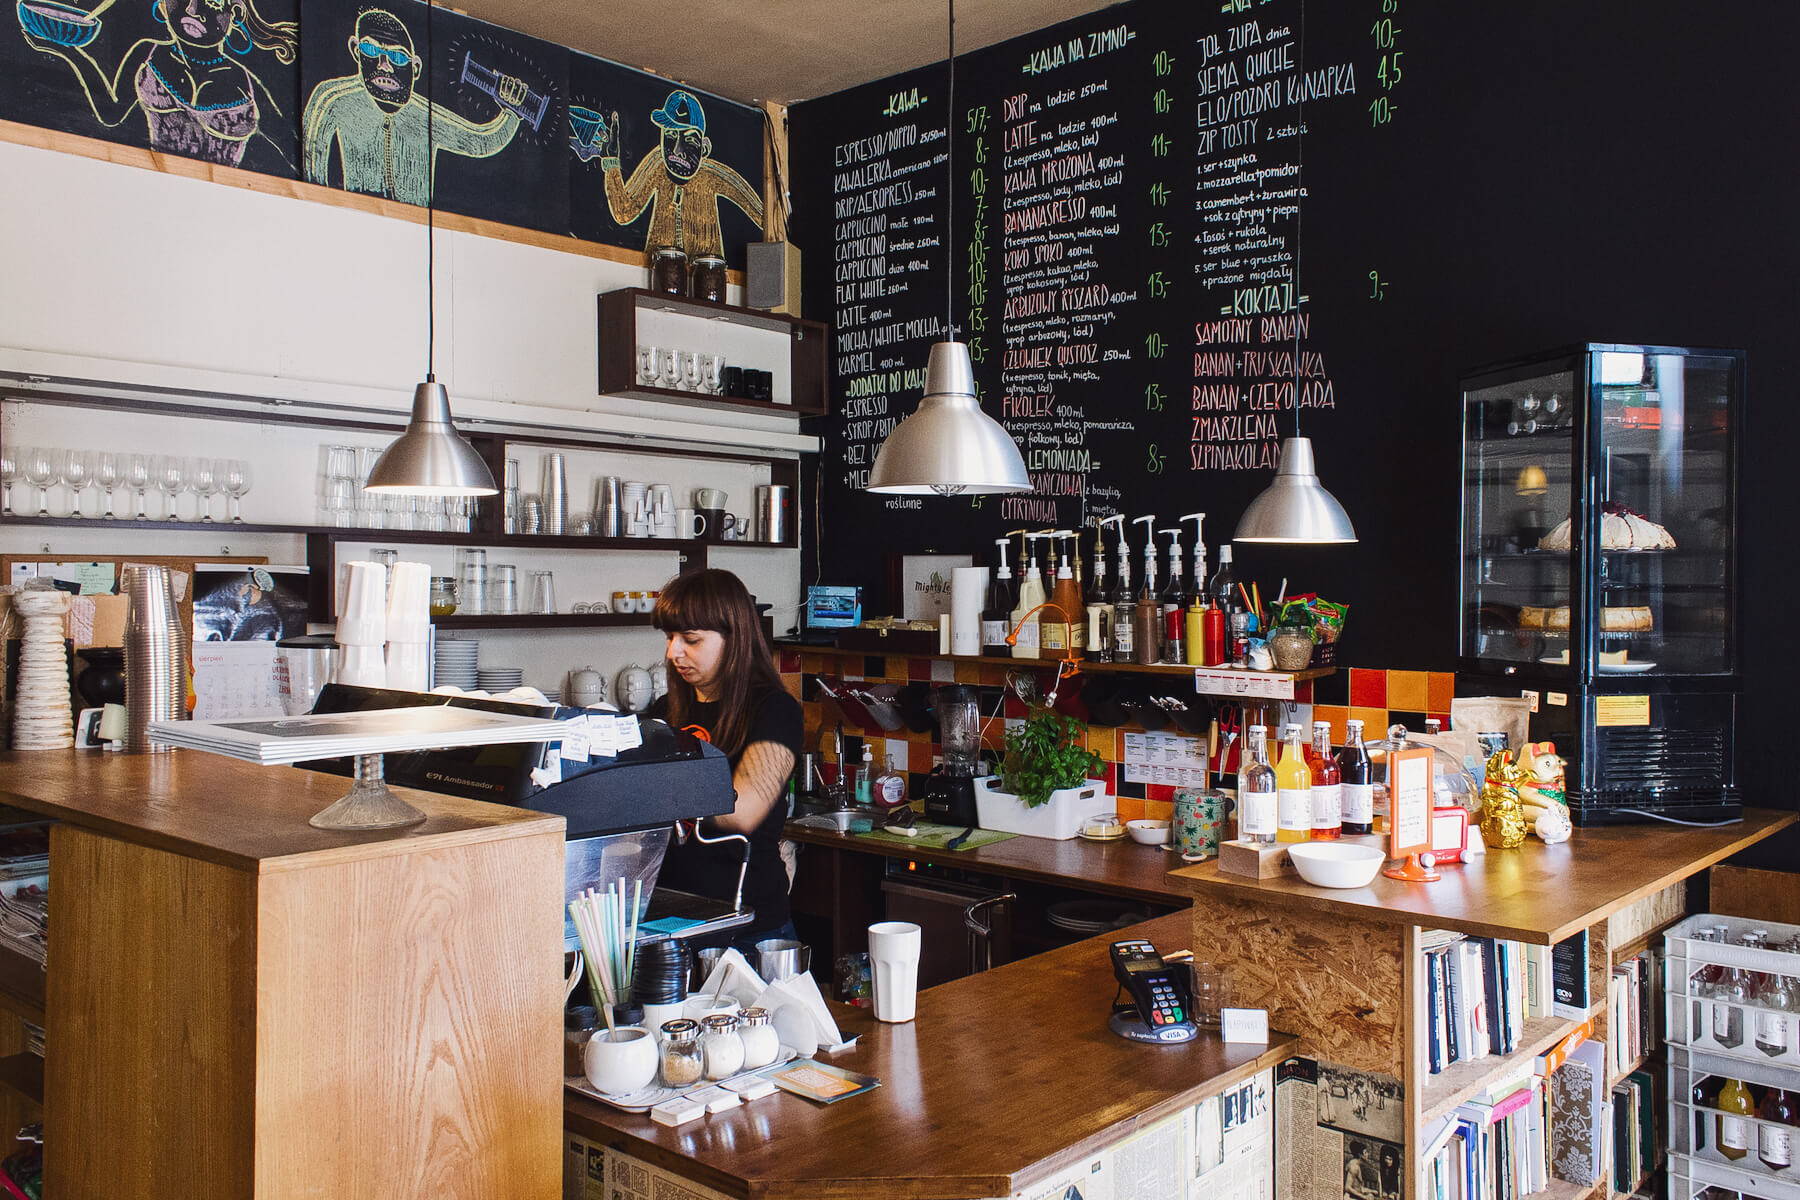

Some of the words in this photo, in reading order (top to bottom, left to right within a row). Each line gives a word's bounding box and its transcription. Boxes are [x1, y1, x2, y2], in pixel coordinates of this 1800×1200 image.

[1068, 37, 1084, 64] NA
[1197, 34, 1223, 68] JOŁ
[1228, 20, 1261, 52] ZUPA
[1266, 26, 1290, 42] dnia
[1198, 61, 1239, 97] SIEMA
[1246, 41, 1295, 82] QUICHE
[1003, 93, 1028, 123] DRIP
[1029, 102, 1042, 114] na
[1047, 89, 1076, 108] lodzie
[1198, 79, 1281, 128] ELO/POZDRO
[1287, 62, 1356, 106] KANAPKA
[836, 124, 917, 167] ESPRESSO/DOPPIO
[1004, 120, 1038, 153] LATTE
[1041, 130, 1053, 142] na
[1058, 120, 1086, 136] lodzie
[1198, 129, 1217, 156] ZIP
[1220, 117, 1258, 150] TOSTY
[1266, 126, 1275, 141] 2
[834, 158, 892, 194] KAWALERKA
[892, 159, 931, 178] americano
[1004, 167, 1037, 195] KAWA
[836, 180, 912, 219] DRIP/AEROPRESS
[1090, 204, 1117, 219] 400ml
[836, 214, 886, 241] CAPPUCCINO
[1235, 223, 1267, 238] rukola
[836, 234, 886, 262] CAPPUCCINO
[1234, 234, 1285, 251] naturalny
[836, 256, 886, 283] CAPPUCCINO
[1004, 248, 1030, 272] KOKO
[1034, 241, 1063, 265] SPOKO
[1203, 262, 1218, 273] ser
[1221, 259, 1241, 270] blue
[1250, 264, 1293, 284] migdały
[836, 283, 857, 304] FLAT
[860, 278, 886, 299] WHITE
[1003, 290, 1058, 320] ARBUZOWY
[1061, 283, 1109, 311] RYSZARD
[1110, 291, 1137, 304] 400ml
[836, 305, 867, 329] LATTE
[1195, 318, 1253, 346] SAMOTNY
[1261, 313, 1310, 343] BANAN
[838, 322, 904, 353] MOCHA/WHITE
[906, 316, 940, 340] MOCHA
[838, 352, 876, 376] KARMEL
[1003, 346, 1054, 370] CZŁOWIEK
[1102, 350, 1132, 362] 250ml
[889, 371, 901, 392] DO
[1003, 394, 1056, 418] FIKOŁEK
[1056, 405, 1085, 419] 400ml
[1191, 414, 1279, 442] ZMARZLENA
[885, 496, 922, 510] roślinne
[1001, 498, 1058, 525] CYTRYNOWA
[915, 580, 942, 594] Mighty
[443, 775, 494, 790] Ambassador
[1167, 1031, 1181, 1039] VISA
